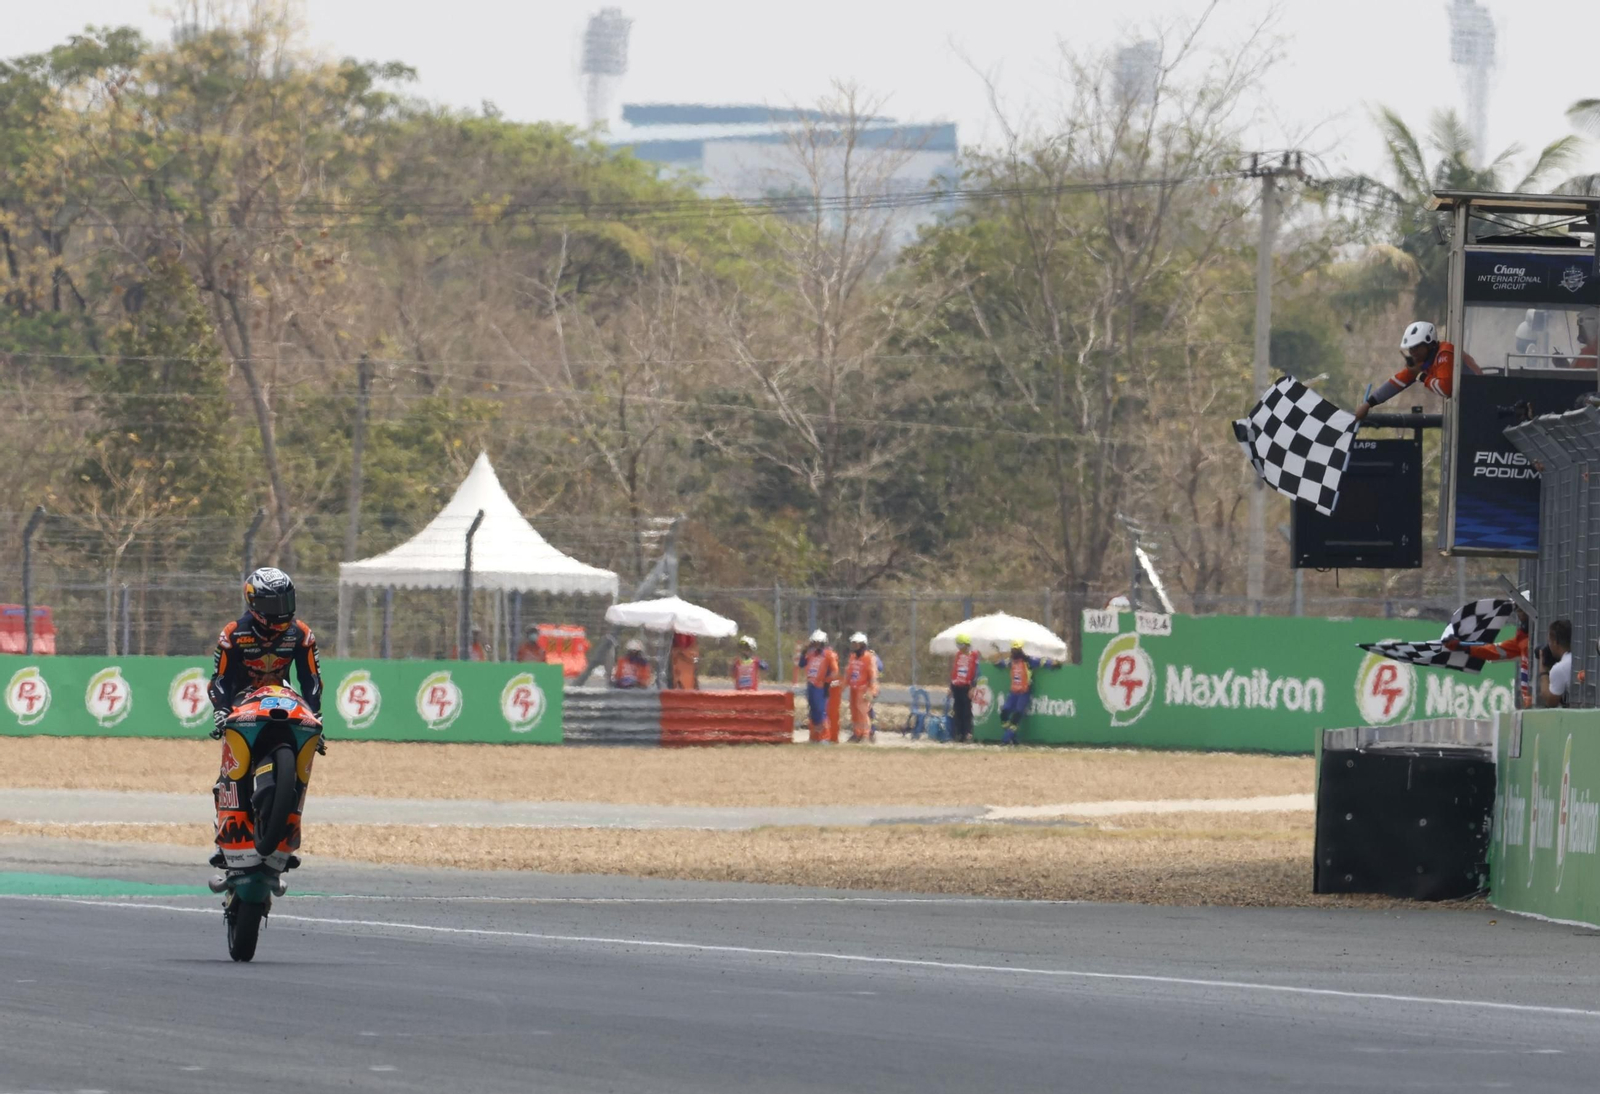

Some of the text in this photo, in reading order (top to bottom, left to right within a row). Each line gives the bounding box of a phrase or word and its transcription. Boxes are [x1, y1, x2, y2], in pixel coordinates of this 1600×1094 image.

[1494, 264, 1526, 276] Chang
[1477, 275, 1542, 283] INTERNATIONAL
[1353, 441, 1377, 449] LAPS
[1474, 451, 1531, 466] FINIS
[1473, 467, 1541, 479] PODIUM
[1164, 664, 1326, 713] Maxnitron
